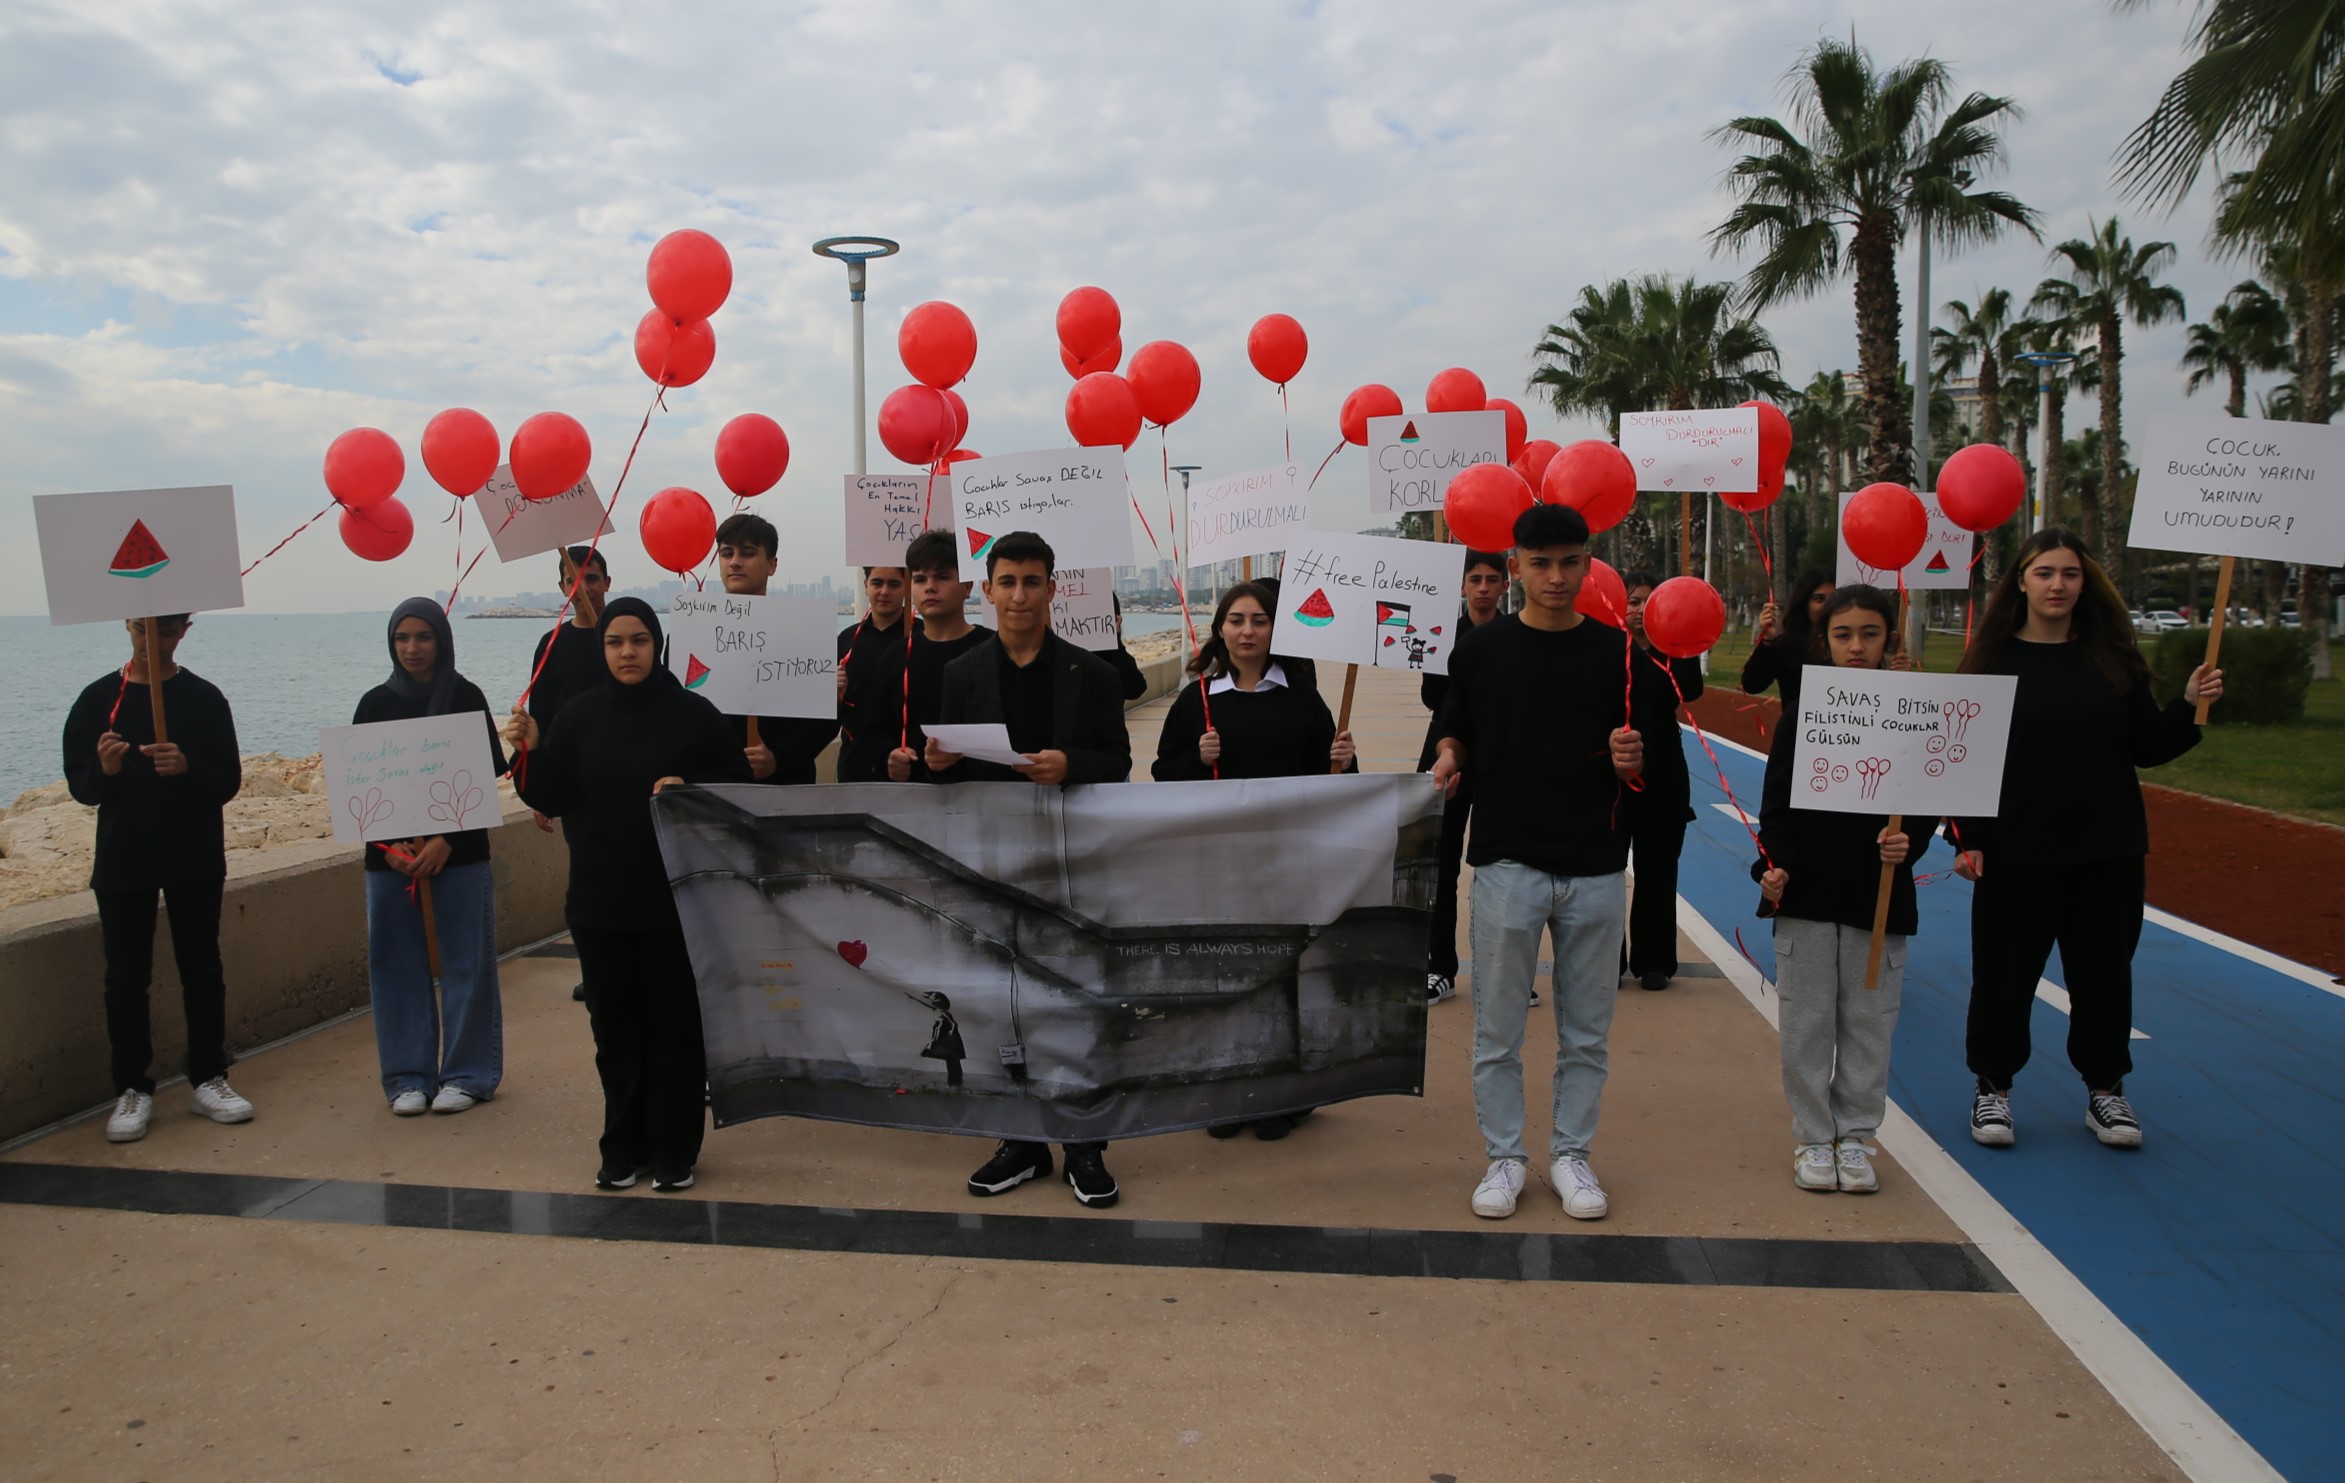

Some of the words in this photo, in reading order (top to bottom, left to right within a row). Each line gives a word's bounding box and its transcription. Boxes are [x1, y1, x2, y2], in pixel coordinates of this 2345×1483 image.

[1629, 414, 1693, 428] SOYKIRIM
[2167, 460, 2246, 478] BUGÜNÜN
[2259, 466, 2315, 481] YARINI
[868, 491, 880, 500] En
[2200, 487, 2263, 504] YARININ
[2164, 511, 2294, 535] UMUDUDUR!
[715, 625, 766, 653] BARIŞ
[1826, 686, 1881, 713] SAVAŞ
[1897, 697, 1939, 715] BİTSİN
[1881, 719, 1939, 732] ÇOCUKLAR
[1805, 729, 1861, 745] GÜLSÜN
[1115, 944, 1160, 957] THERE
[1164, 943, 1181, 955] IS
[1186, 942, 1254, 957] ALWAYS
[1257, 943, 1296, 956] HOPE
